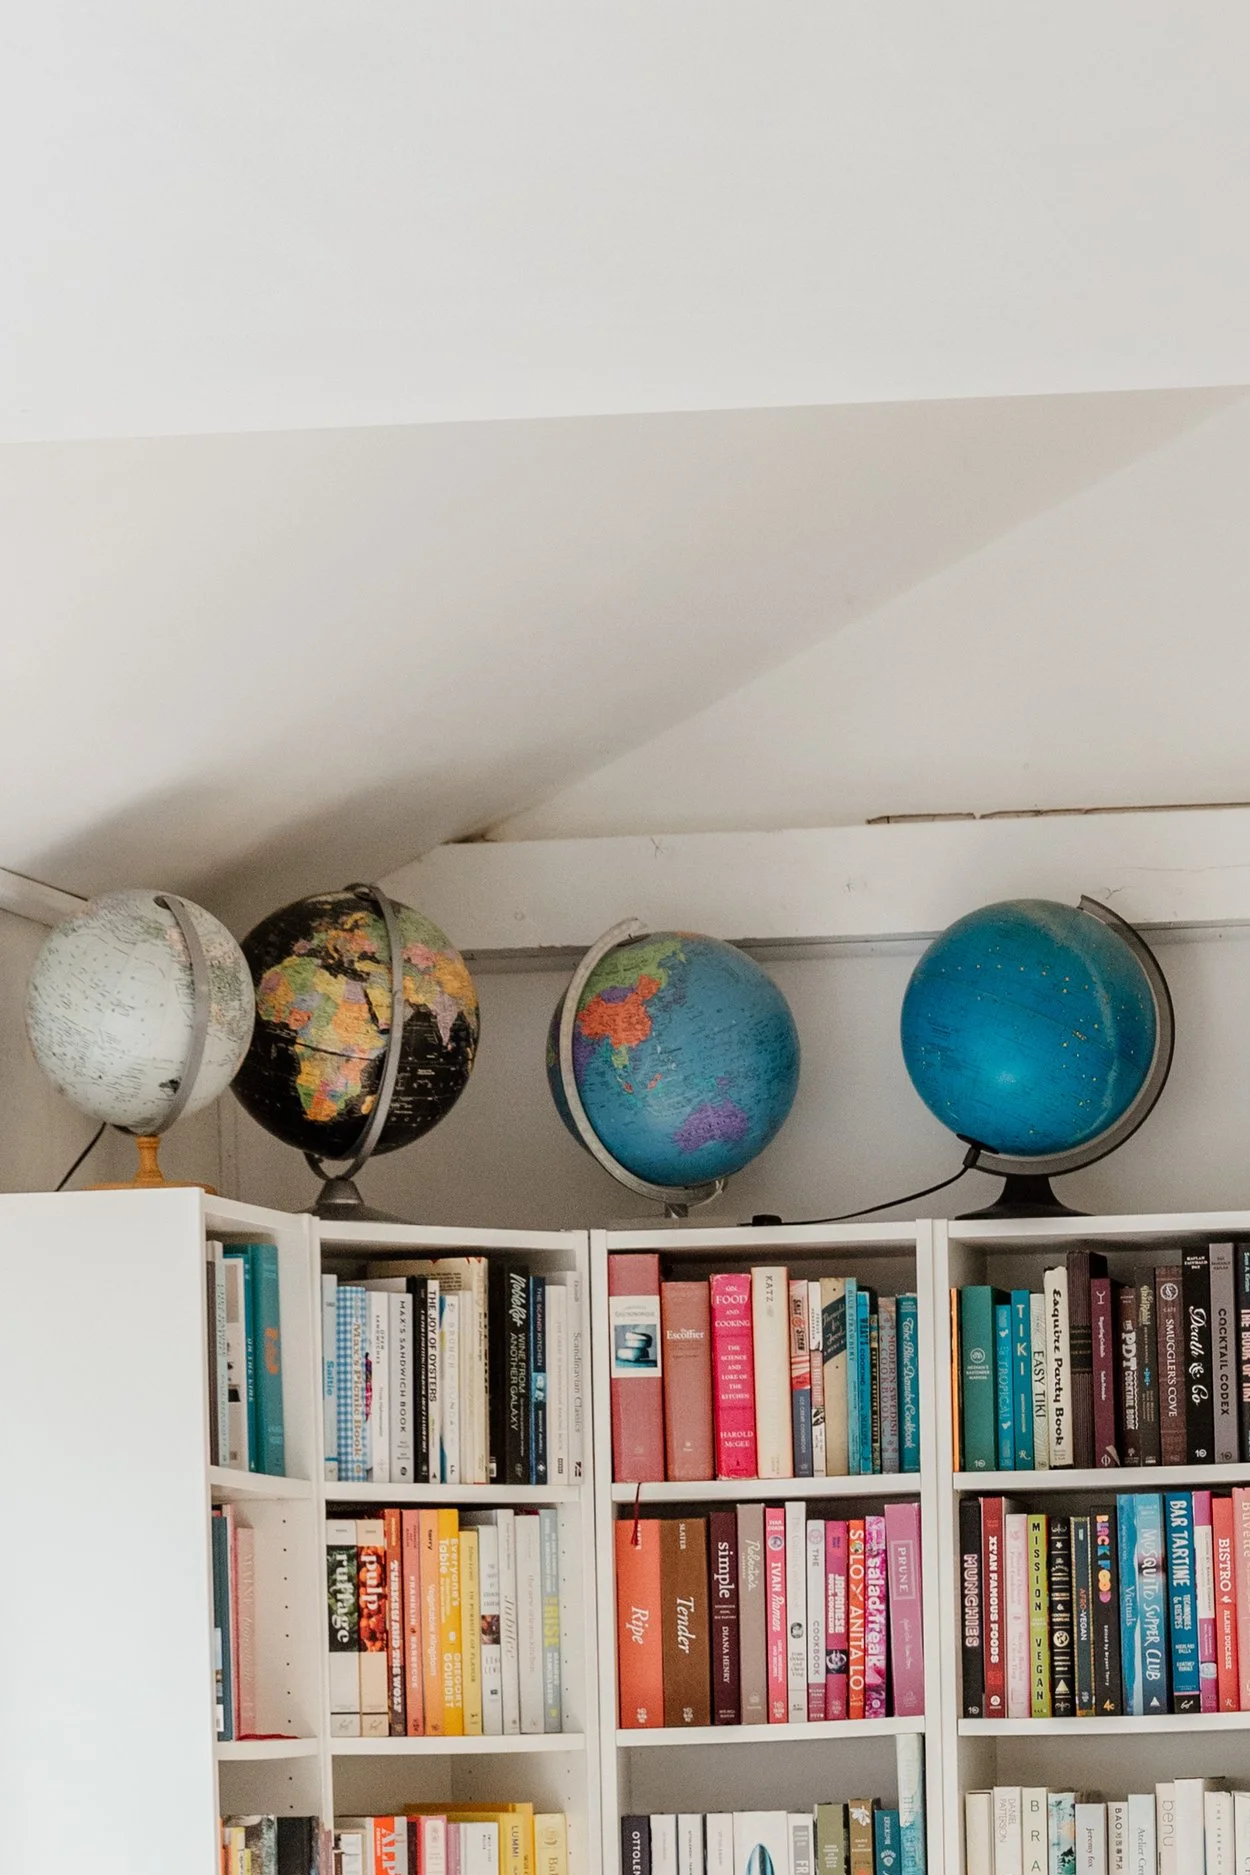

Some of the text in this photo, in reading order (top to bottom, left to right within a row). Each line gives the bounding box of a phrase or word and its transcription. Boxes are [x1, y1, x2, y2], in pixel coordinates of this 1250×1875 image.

[716, 1295, 748, 1305] FOOD
[428, 1291, 437, 1402] THE JOY OF OYSTERS
[518, 1333, 526, 1358] WINE
[1218, 1309, 1230, 1415] COCKTAIL CODEX
[510, 1333, 519, 1430] ANOTHER GALAXY
[1033, 1351, 1046, 1417] EASY TIKI
[439, 1540, 450, 1574] Table
[714, 1541, 734, 1598] simple
[898, 1546, 908, 1593] PRUNE
[1096, 1514, 1111, 1603] BLACK FOOD
[1170, 1500, 1190, 1587] BAR TARTINE
[1218, 1538, 1231, 1591] BISTRO
[335, 1553, 355, 1644] ruffage
[364, 1555, 386, 1610] pulp
[964, 1554, 977, 1646] MUNCHIES
[1125, 1586, 1136, 1627] Victuals
[629, 1607, 649, 1644] Ripe
[675, 1597, 695, 1653] Tender
[868, 1556, 884, 1667] salad freak
[1223, 1635, 1232, 1670] DUCASSE
[511, 1825, 519, 1858] LUMMI
[1114, 1807, 1122, 1830] BAO
[1161, 1799, 1176, 1847] benu
